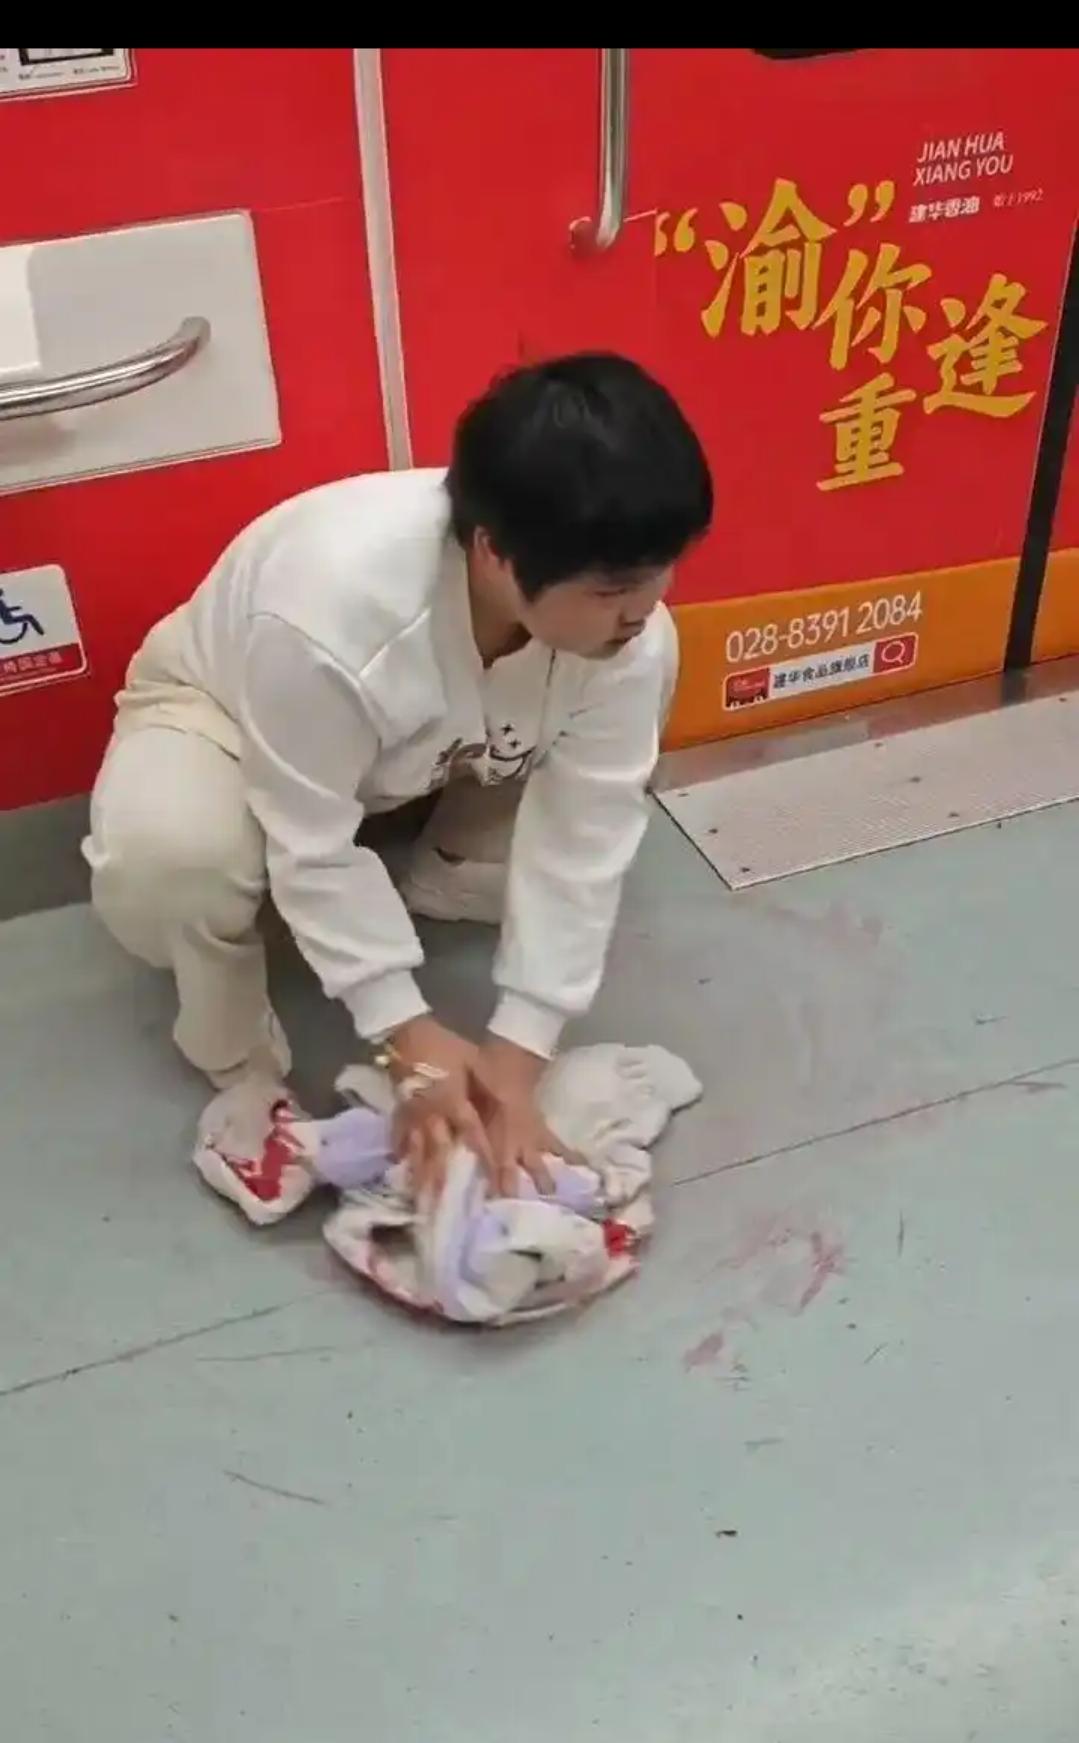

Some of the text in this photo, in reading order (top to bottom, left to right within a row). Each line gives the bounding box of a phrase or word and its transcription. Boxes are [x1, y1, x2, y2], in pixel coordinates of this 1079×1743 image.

[917, 131, 1004, 163] JIAN HUA
[912, 154, 1014, 186] XIANG YOU
[726, 591, 922, 663] 028-8391 2084
